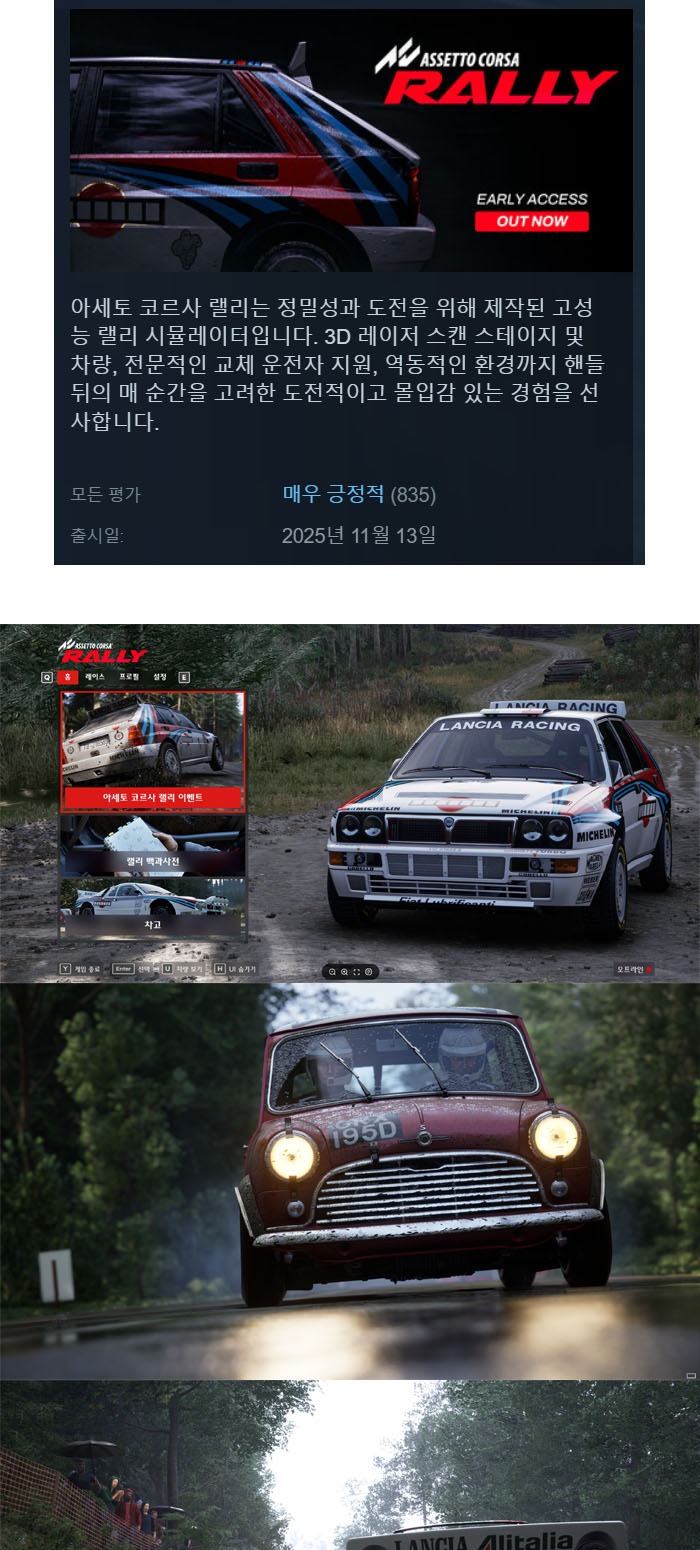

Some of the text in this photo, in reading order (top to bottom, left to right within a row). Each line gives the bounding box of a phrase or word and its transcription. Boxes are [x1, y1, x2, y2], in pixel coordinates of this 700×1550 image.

[420, 53, 519, 67] ASSETTO CORSA
[384, 70, 619, 105] RALLY
[476, 194, 588, 206] EARLY ACCESS
[497, 215, 569, 227] OUT NOW
[72, 298, 592, 318] 아세토 코르사 랠리는 정밀성과 도전을 위해 제작된 고성
[71, 326, 583, 346] 능 랠리 시뮬레이터입니다. 3D 레이저 스캔 스테이지 및
[72, 355, 605, 376] 차량, 전문적인 교체 운전자 지원, 역동적인 환경까지 핸들
[71, 383, 598, 403] 뒤의 매 순간을 고려한 도전적이고 몰입감 있는 경험을 선
[71, 412, 158, 432] 사합니다.
[70, 487, 141, 503] 모든 평가
[284, 485, 436, 506] 매우 긍정적 (835)
[71, 528, 124, 544] 출시일:
[282, 526, 435, 544] 2025년 11월 13일
[62, 649, 148, 662] RALLY
[43, 673, 51, 681] Q
[64, 673, 71, 681] 홈
[85, 673, 105, 681] 레이스
[120, 673, 139, 681] 프로필
[153, 673, 167, 681] 설정
[557, 702, 618, 713] RACING
[440, 720, 581, 732] LANCIA RACING
[103, 793, 128, 803] 아세토
[131, 793, 156, 803] 코르사
[178, 793, 203, 803] 이벤트
[577, 828, 615, 842] MICHELIN
[146, 857, 180, 867] 백과사전
[144, 921, 161, 930] 차고
[333, 1120, 397, 1148] 195D
